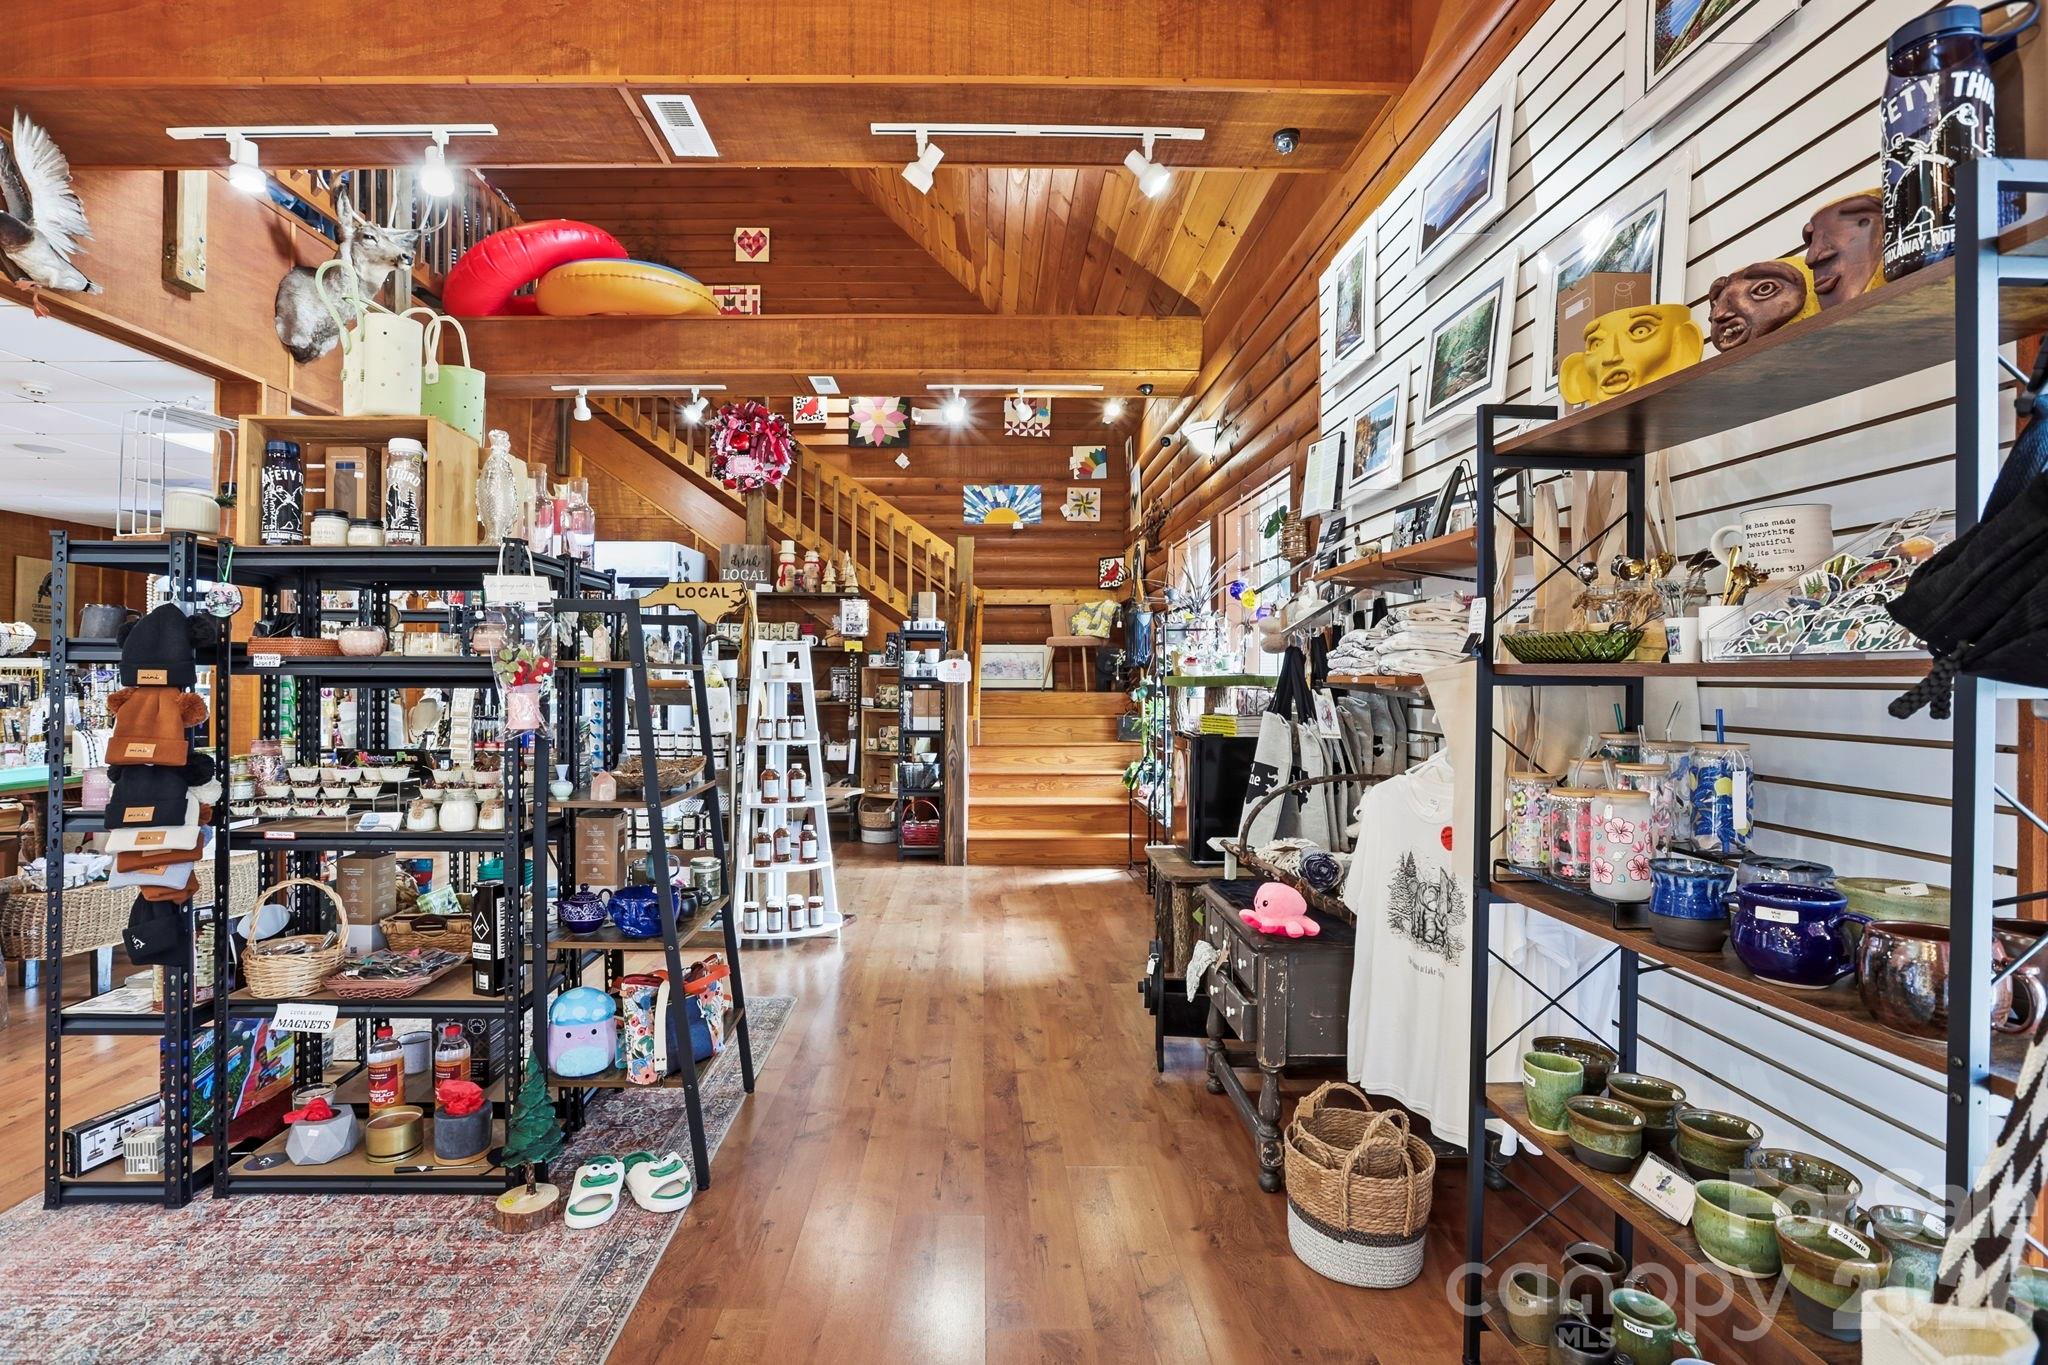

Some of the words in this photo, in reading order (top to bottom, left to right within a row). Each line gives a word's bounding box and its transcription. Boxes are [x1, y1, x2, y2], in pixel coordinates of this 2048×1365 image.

[262, 467, 297, 484] AFETY
[391, 467, 421, 488] THIRD
[1772, 518, 1796, 526] made
[730, 551, 760, 568] drink
[722, 568, 768, 581] LOCAL
[676, 586, 730, 598] LOCAL
[276, 1018, 331, 1030] MAGNETS
[1833, 1227, 1848, 1240] $20
